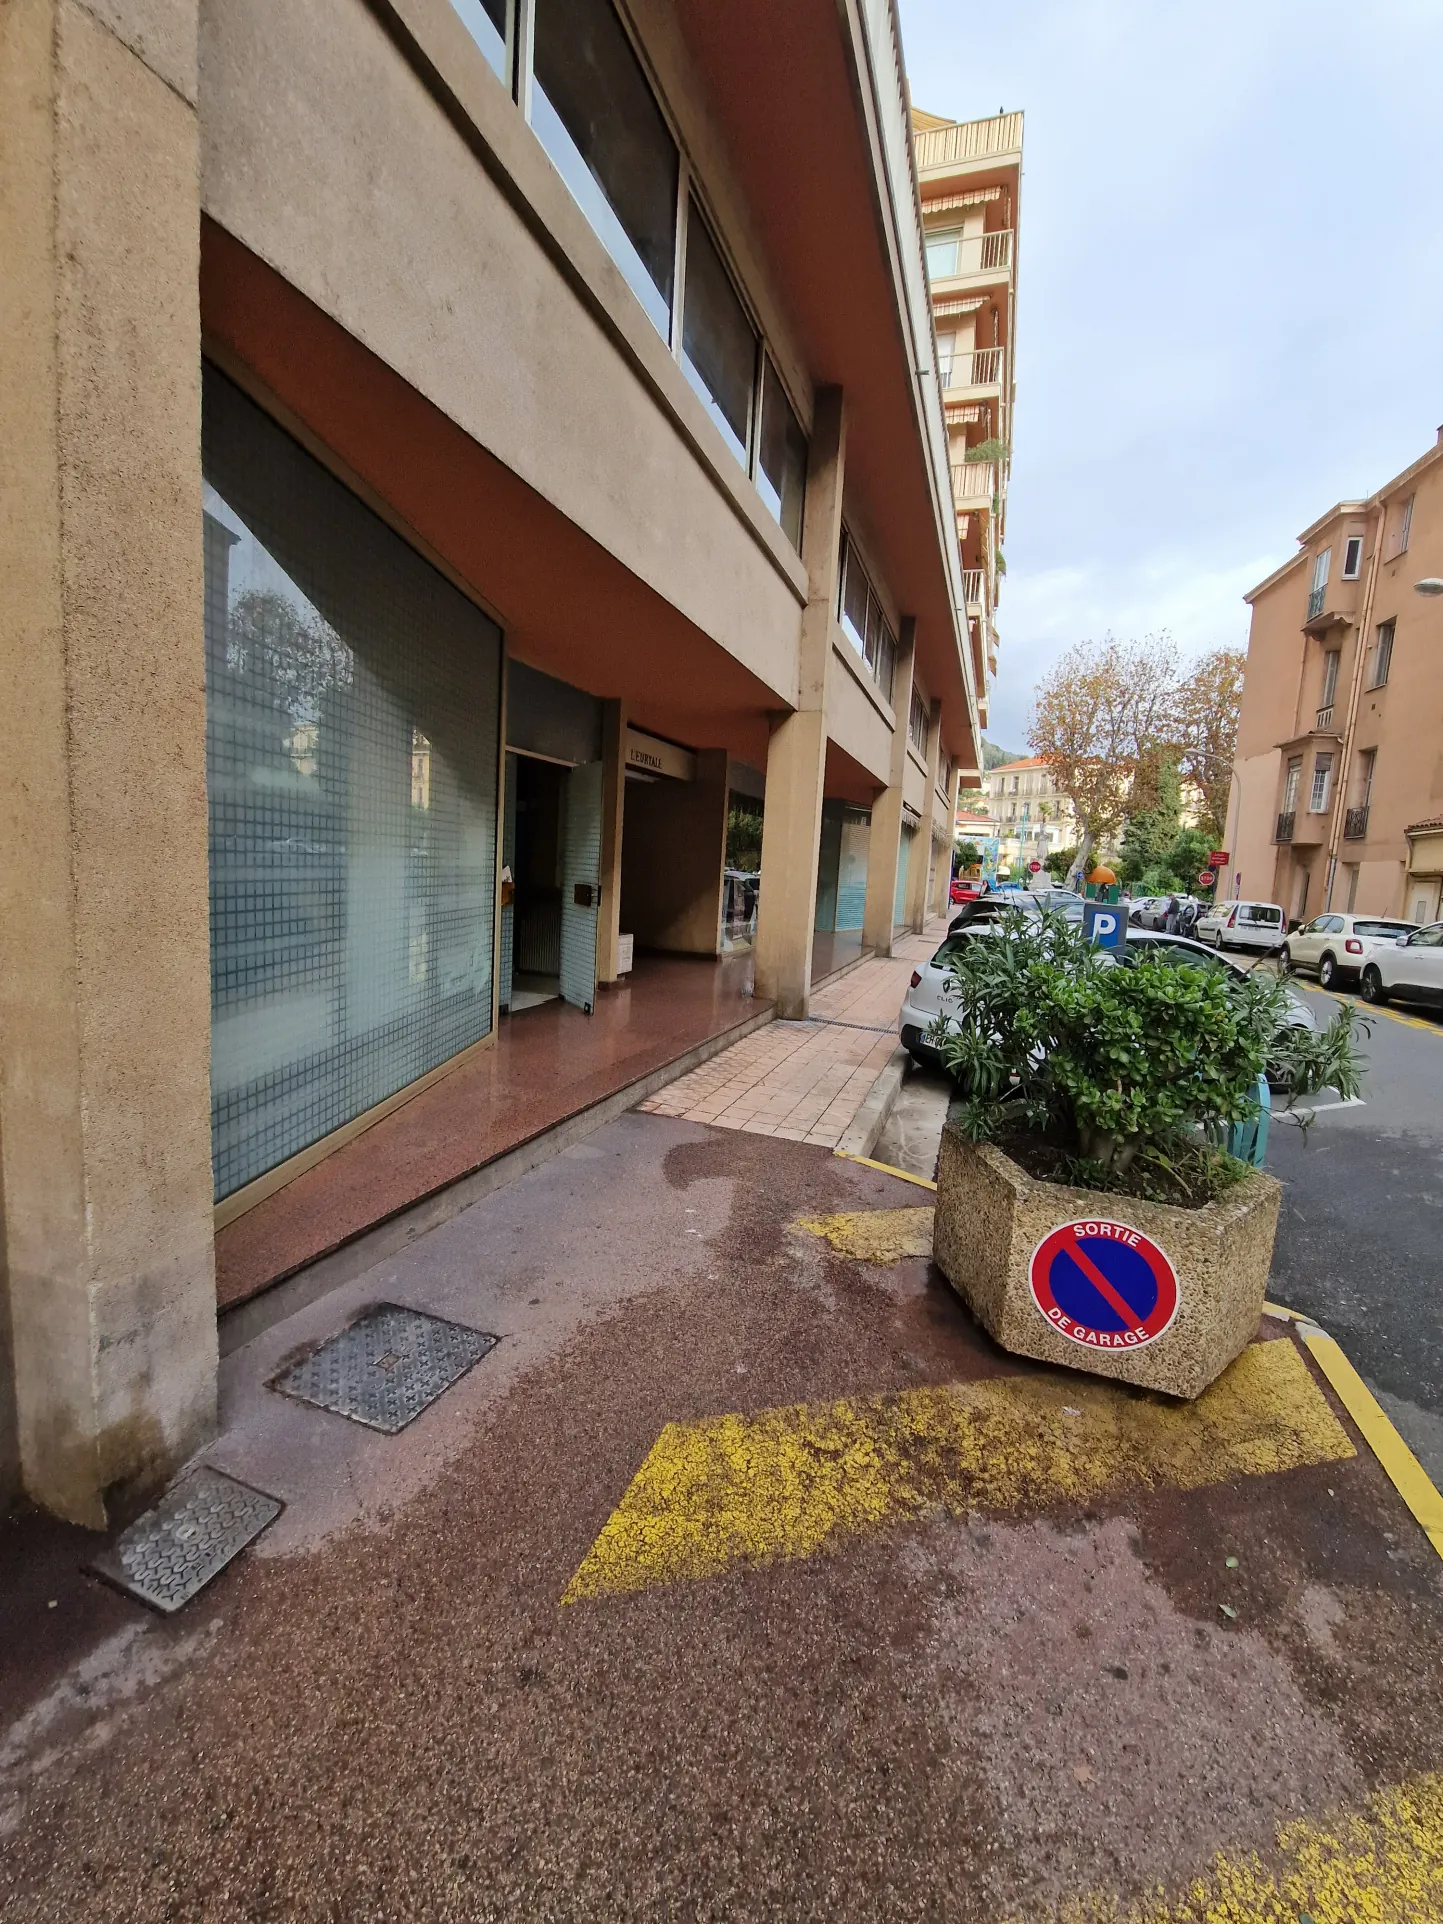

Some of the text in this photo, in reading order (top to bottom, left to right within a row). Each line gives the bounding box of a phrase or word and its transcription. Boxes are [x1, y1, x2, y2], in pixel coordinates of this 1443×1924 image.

[1092, 913, 1116, 944] P
[936, 995, 953, 1003] CLIO
[1073, 1223, 1142, 1247] SORTIE
[1047, 1307, 1149, 1346] DE GARAGE
